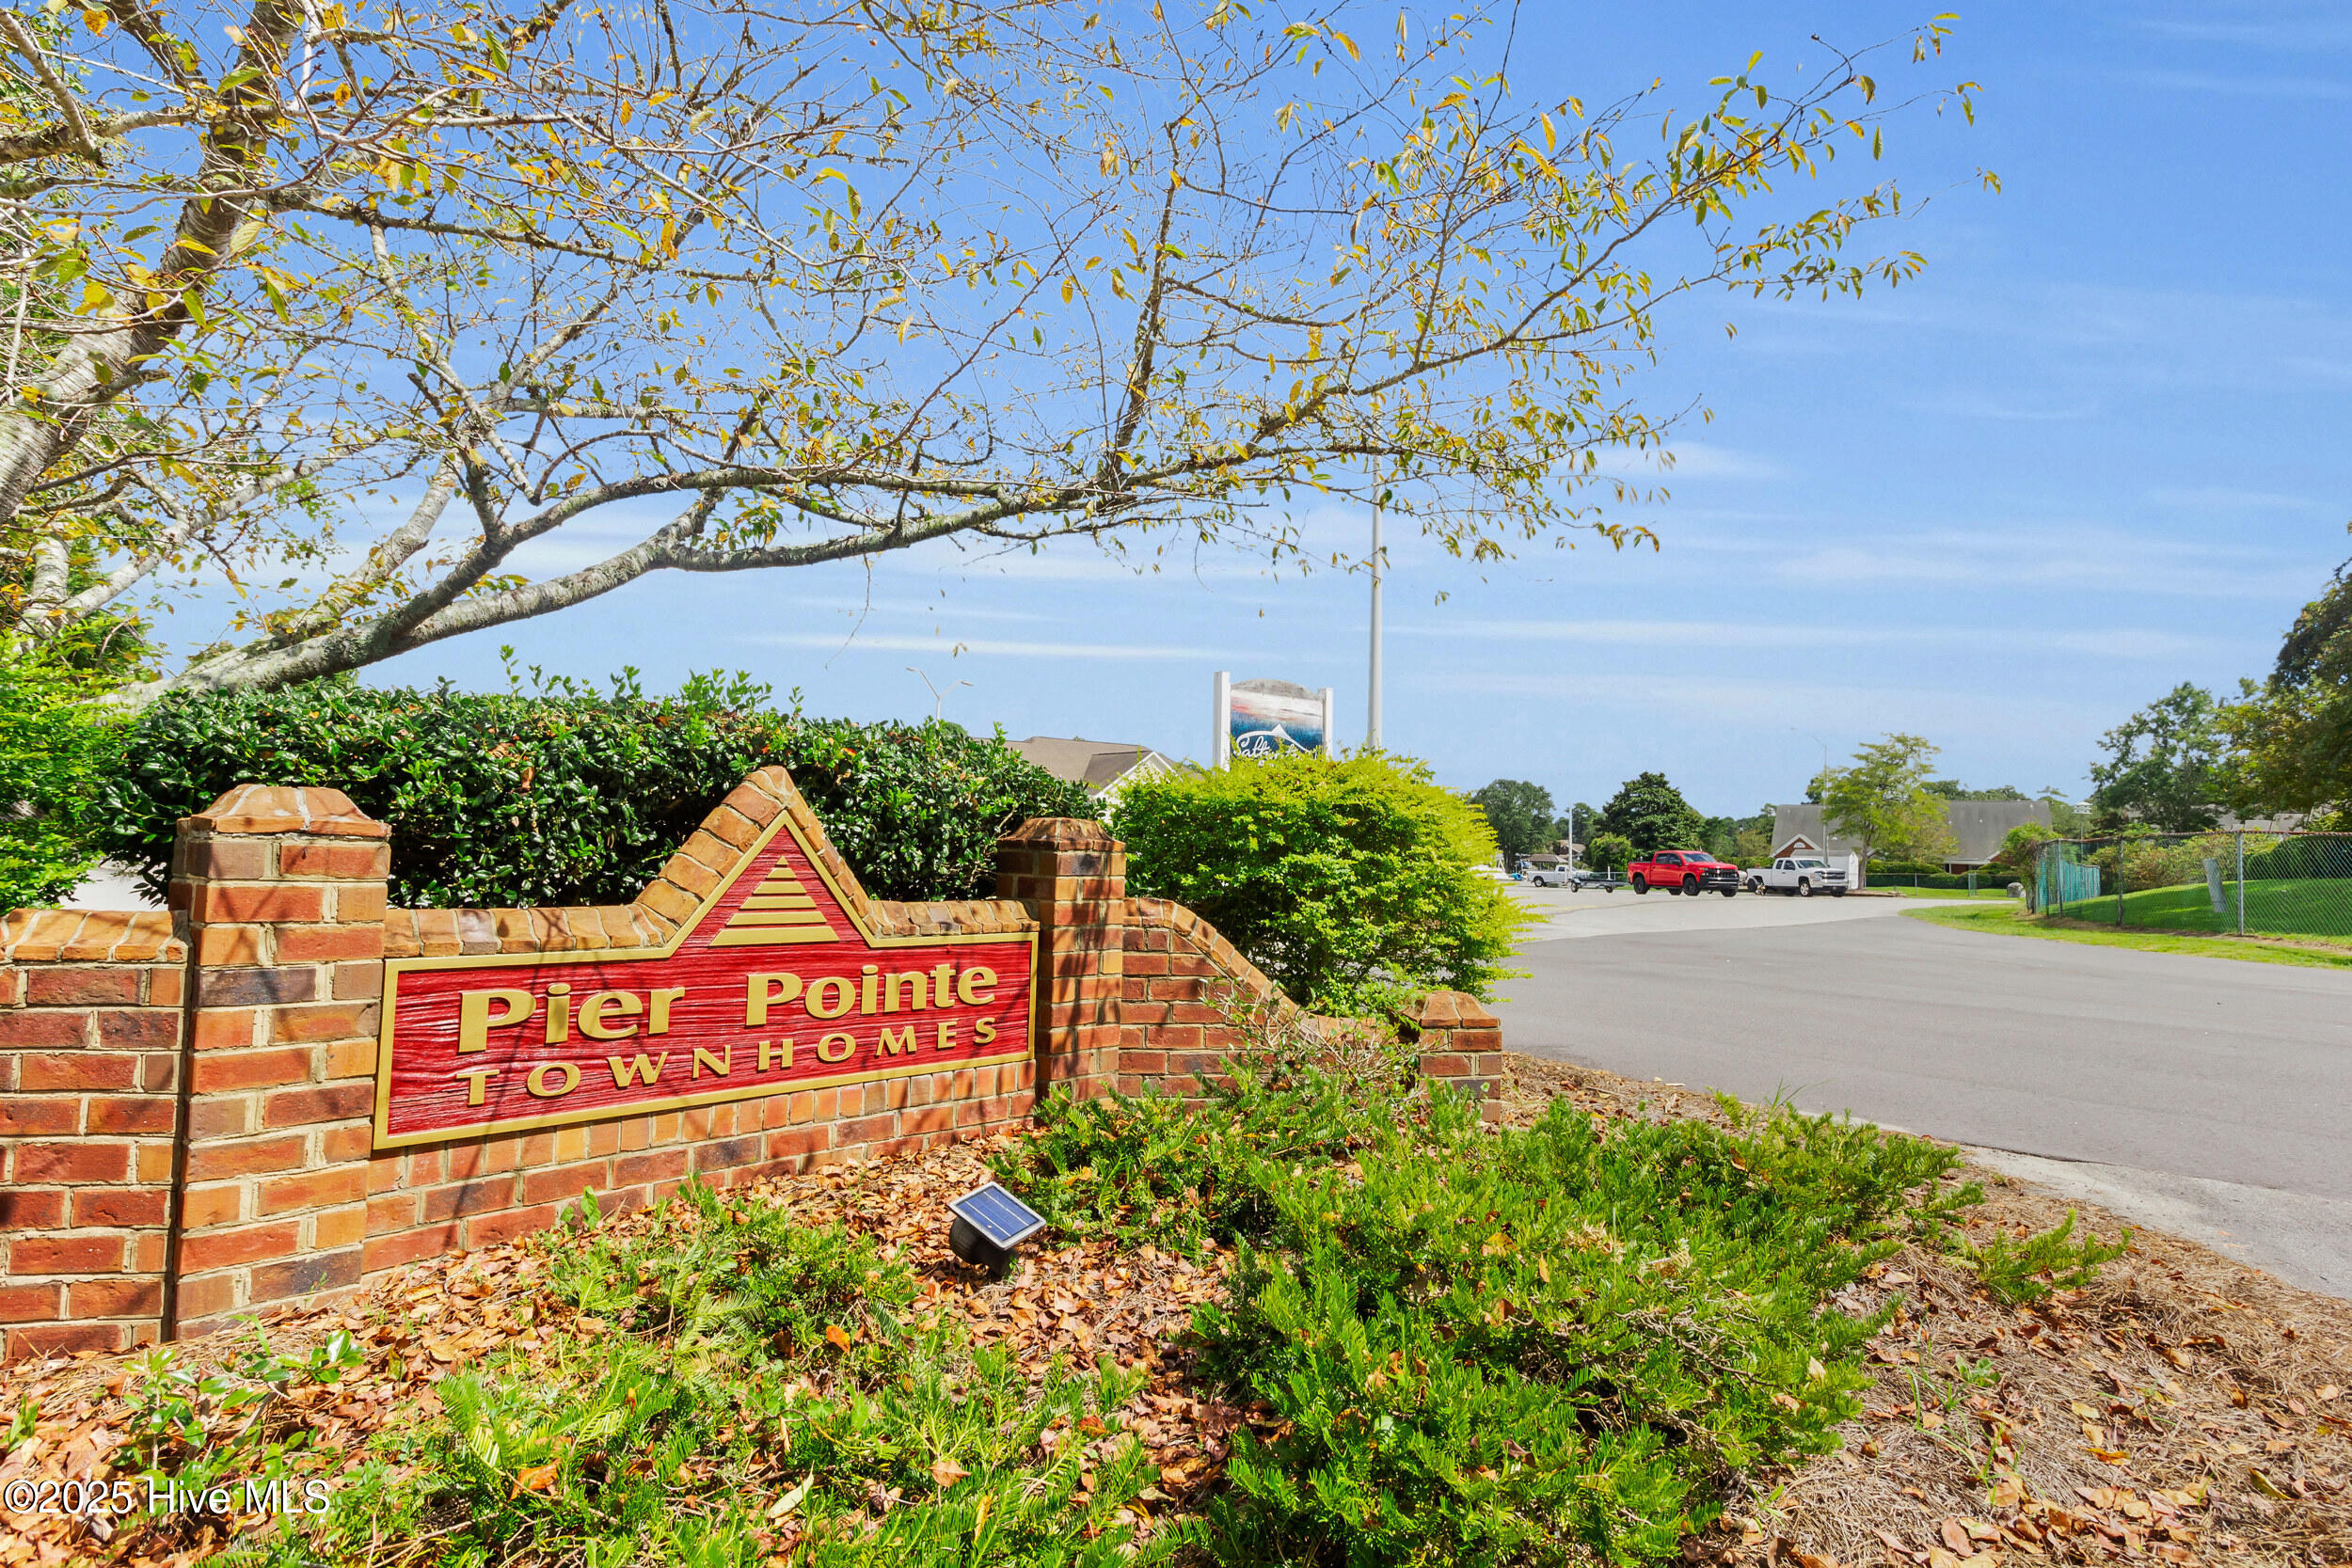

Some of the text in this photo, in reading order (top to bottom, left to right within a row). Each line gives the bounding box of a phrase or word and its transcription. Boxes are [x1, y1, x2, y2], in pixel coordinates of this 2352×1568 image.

[457, 963, 998, 1053] Pier Pointe
[456, 1016, 998, 1104] TOWNHOMES
